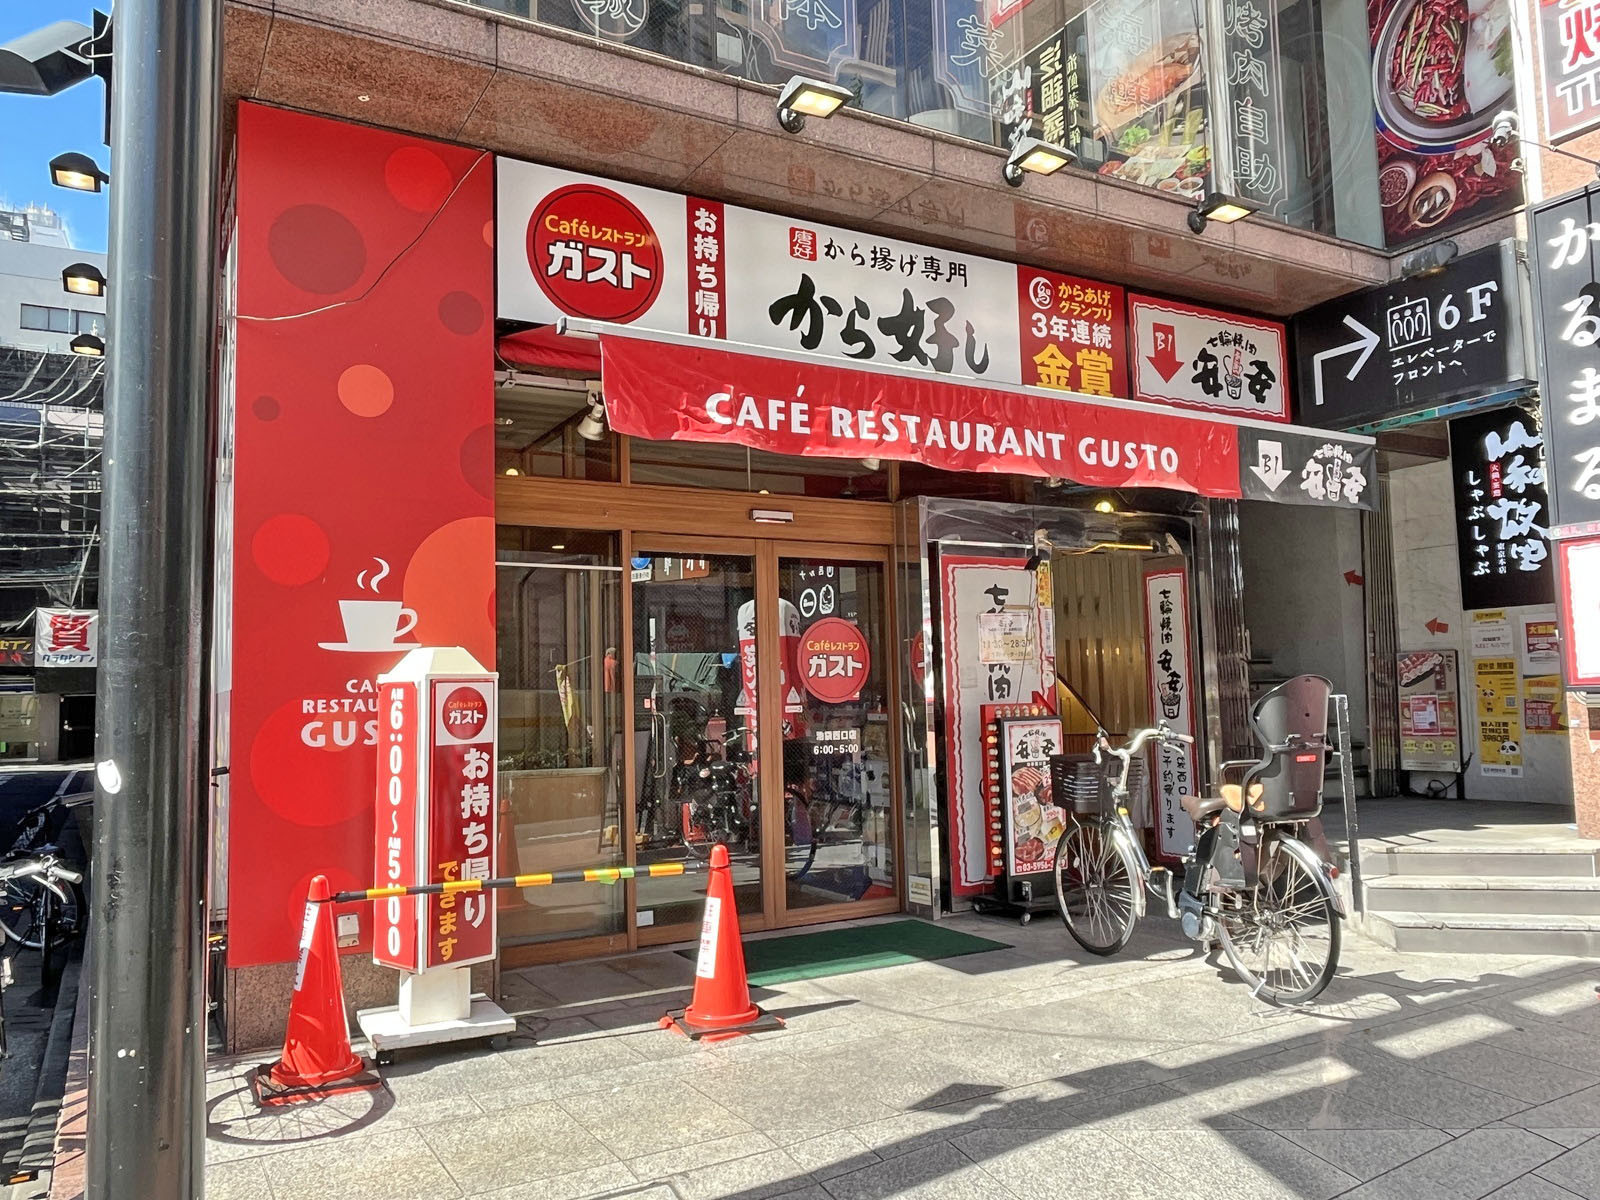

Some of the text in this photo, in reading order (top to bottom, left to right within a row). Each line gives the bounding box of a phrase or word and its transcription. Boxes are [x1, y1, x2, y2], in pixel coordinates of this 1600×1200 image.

[544, 213, 649, 248] Caféレストラン
[547, 241, 652, 290] ガスト
[693, 207, 720, 338] お持ち帰り
[823, 237, 967, 287] から揚げ専門
[1058, 282, 1111, 307] からあげ
[1059, 300, 1112, 321] グランプリ
[1438, 280, 1499, 330] 6F
[768, 273, 989, 373] から好し
[1031, 312, 1112, 349] 3年連続
[1155, 333, 1173, 352] B1
[1391, 329, 1497, 368] エレベーターで
[1548, 217, 1600, 500] かるまる
[1032, 343, 1114, 397] 金賞
[1393, 358, 1463, 385] フロントへ
[705, 386, 1179, 474] CAFÉ RESTAURANT GUSTO
[1261, 453, 1279, 475] B1
[1468, 470, 1491, 576] しゃぶしゃぶ
[48, 615, 91, 651] 質
[1158, 589, 1174, 645] 七輪焼肉
[806, 640, 860, 651] Caféレストラン
[984, 584, 1012, 701] 七肉
[808, 654, 863, 678] ガスト
[346, 679, 378, 693] CA
[302, 699, 378, 714] RESTAU
[448, 709, 484, 725] ガスト
[300, 720, 378, 748] GUS
[460, 747, 490, 929] お持ち帰り
[437, 860, 458, 961] できます
